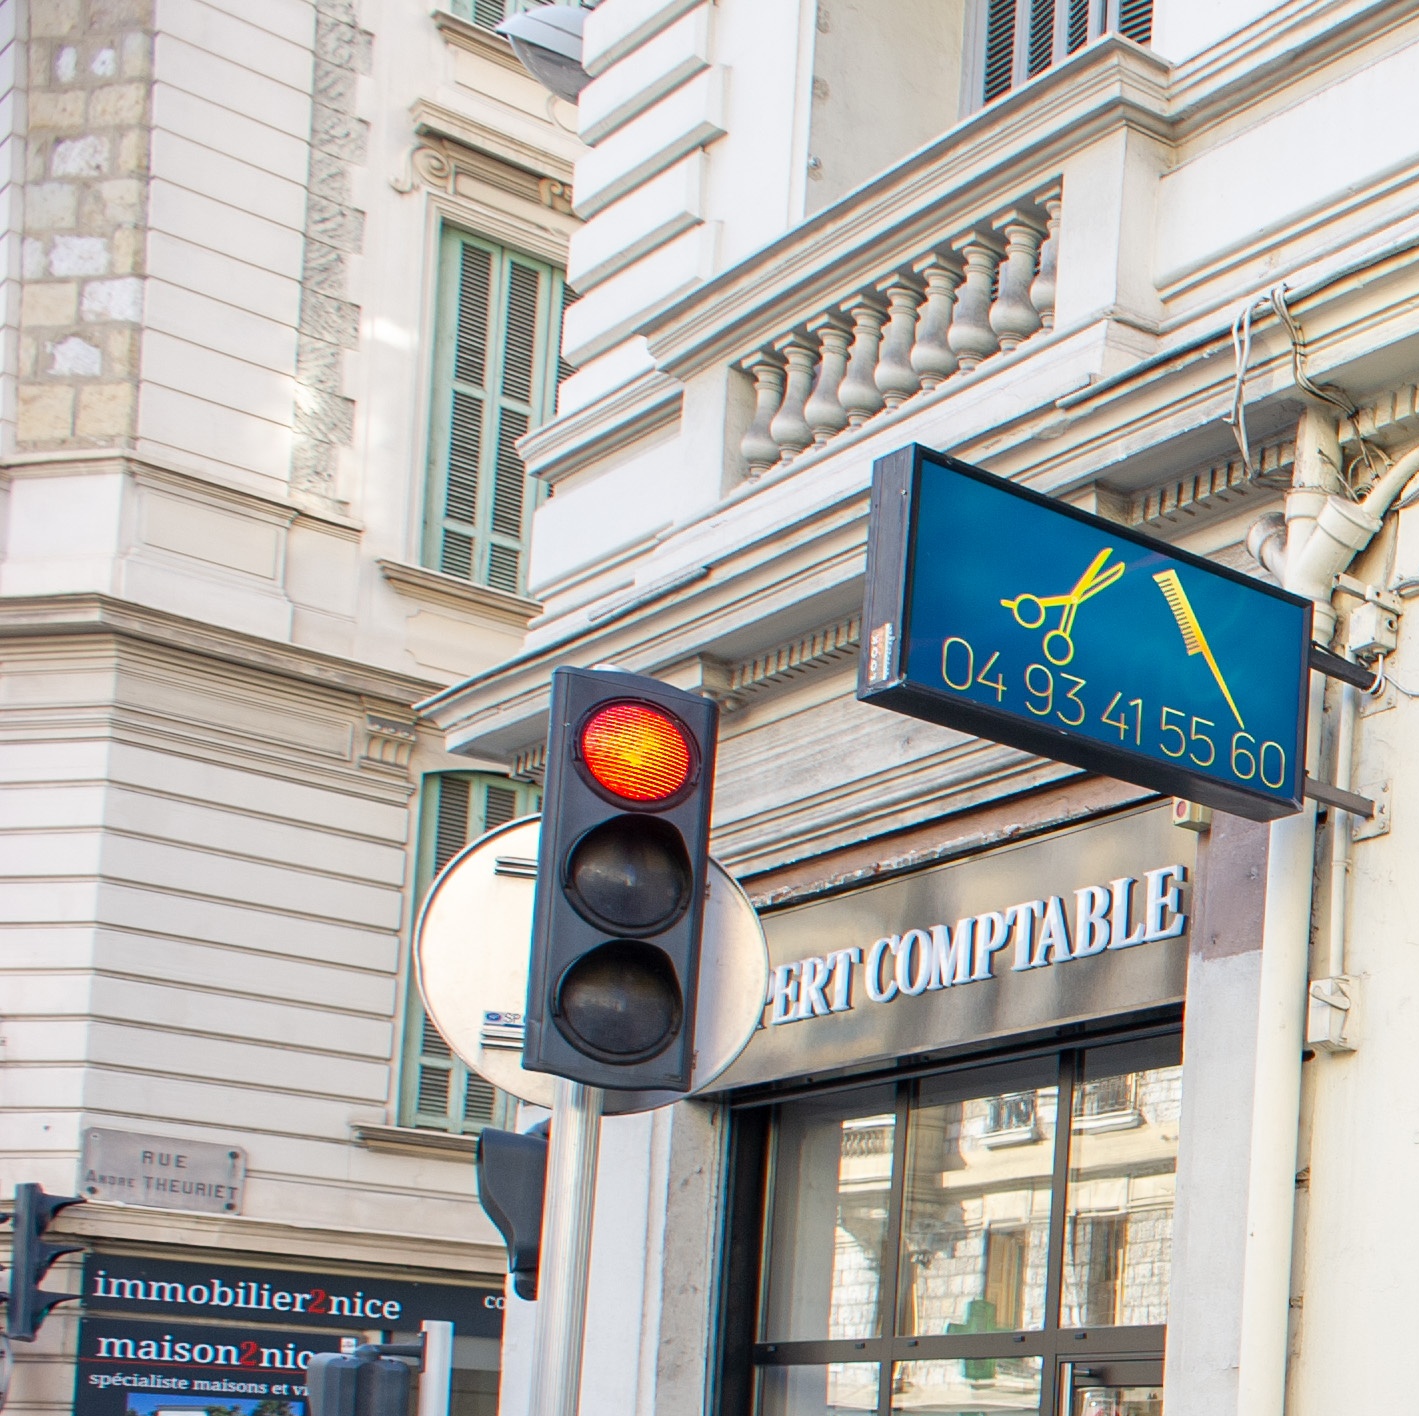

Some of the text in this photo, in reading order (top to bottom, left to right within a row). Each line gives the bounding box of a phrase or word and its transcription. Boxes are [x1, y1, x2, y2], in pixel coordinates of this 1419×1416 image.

[941, 637, 1286, 788] 04 93 41 55 60
[865, 864, 1187, 1003] COMPTABLE
[142, 1150, 189, 1169] RUE
[143, 1176, 238, 1200] THEURIET
[92, 1270, 402, 1320] immobilier2nice
[95, 1334, 314, 1369] maison2nic
[88, 1372, 190, 1389] spécialiste
[192, 1378, 267, 1394] maisons
[271, 1382, 288, 1395] et
